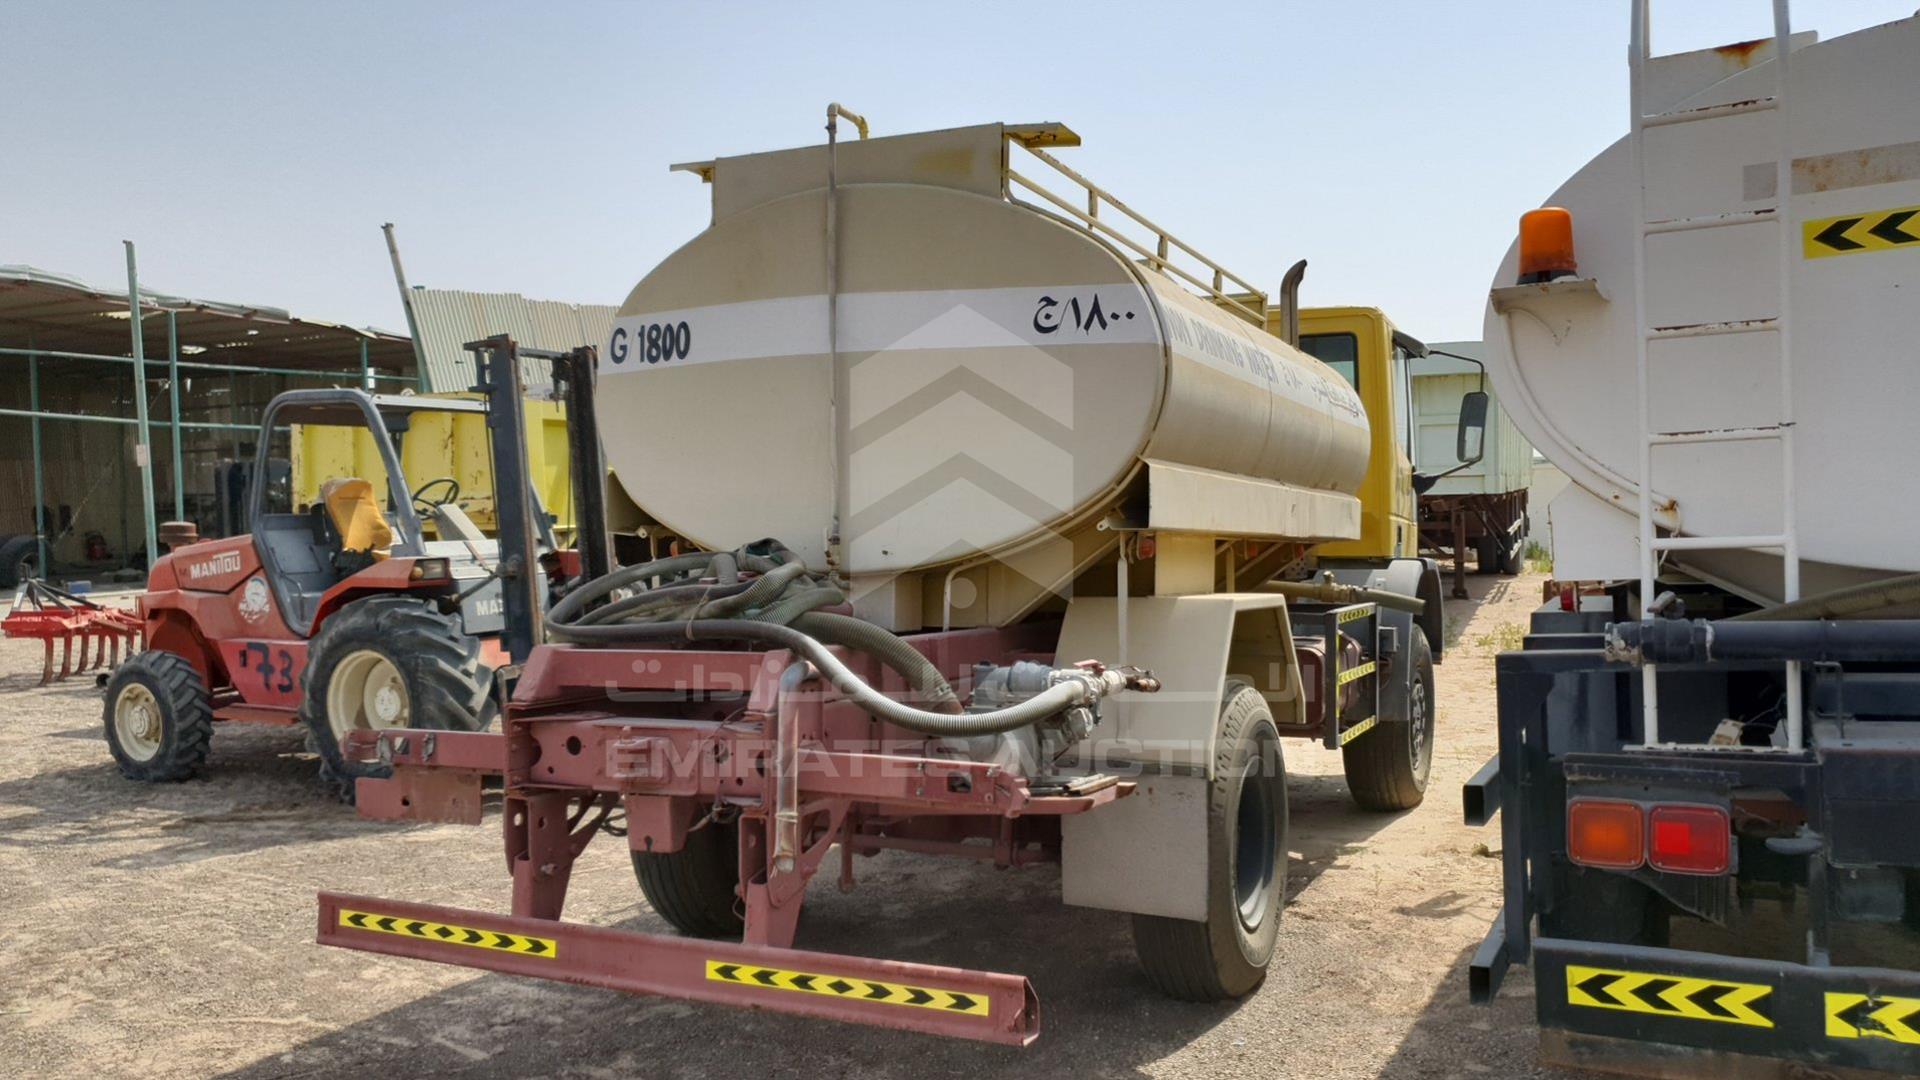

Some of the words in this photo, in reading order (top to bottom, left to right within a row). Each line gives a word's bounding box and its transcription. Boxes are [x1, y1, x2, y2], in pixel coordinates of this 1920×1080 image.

[638, 321, 690, 364] 1800
[190, 550, 241, 579] MANITOU
[246, 642, 293, 693] 73
